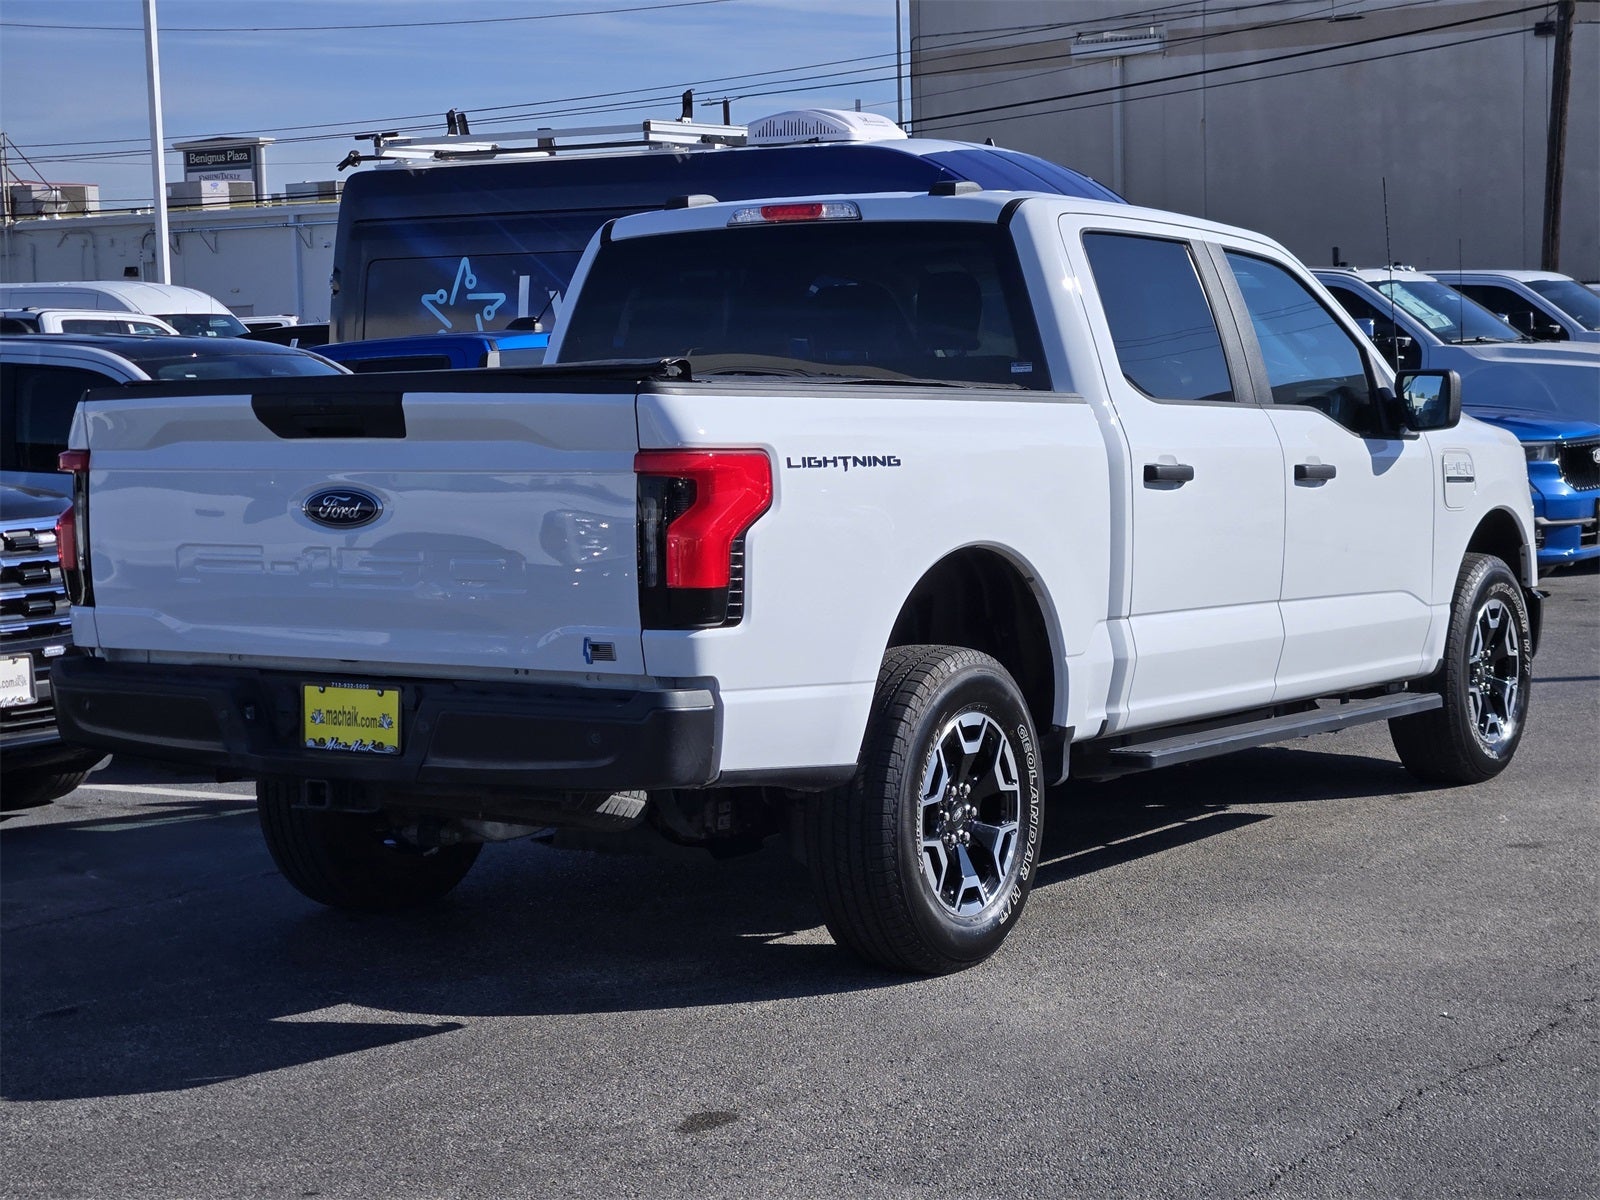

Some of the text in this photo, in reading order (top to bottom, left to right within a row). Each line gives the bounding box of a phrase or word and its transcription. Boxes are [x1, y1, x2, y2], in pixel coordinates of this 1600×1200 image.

[189, 150, 248, 165] Benignus Plaza
[786, 455, 902, 472] LIGHTNING
[318, 495, 361, 519] Ford
[175, 542, 528, 594] F-150
[325, 706, 378, 729] machaik.com
[324, 737, 349, 750] Mac
[350, 739, 376, 752] Haik
[998, 723, 1039, 925] GEOLANDAR H/T
